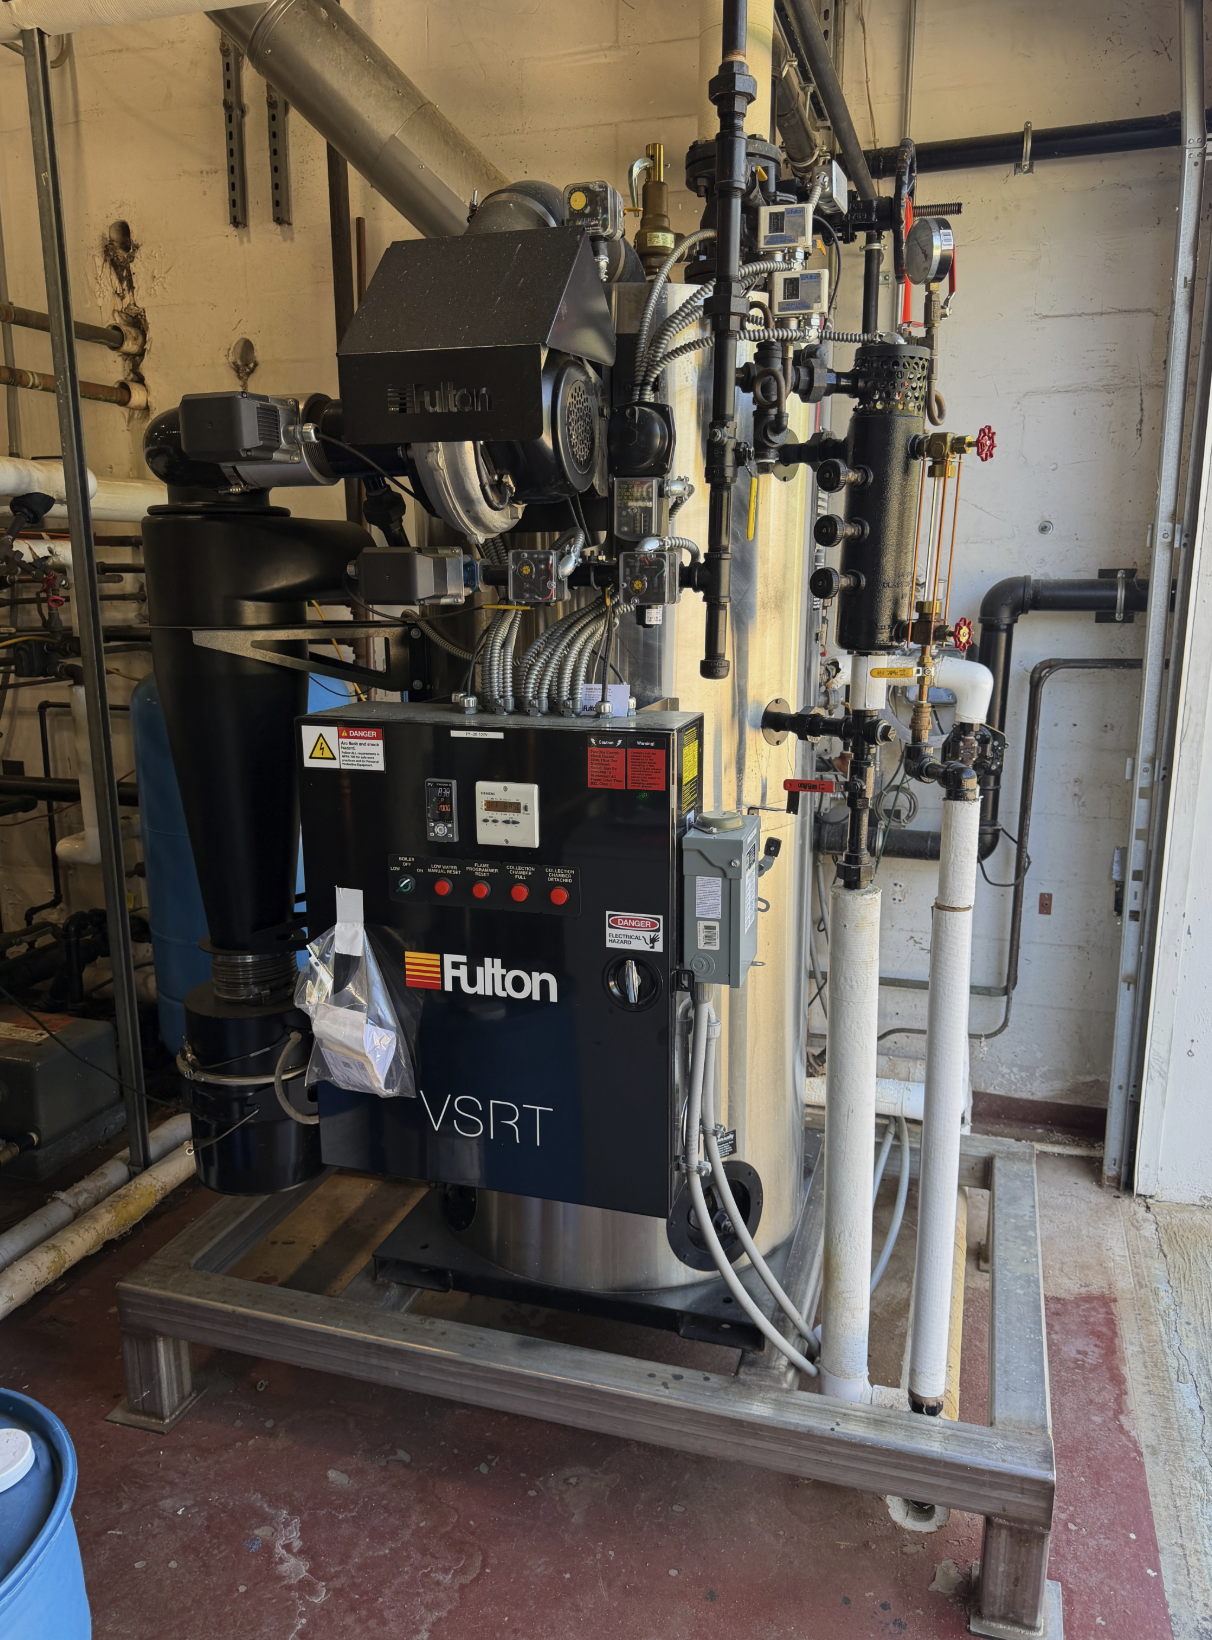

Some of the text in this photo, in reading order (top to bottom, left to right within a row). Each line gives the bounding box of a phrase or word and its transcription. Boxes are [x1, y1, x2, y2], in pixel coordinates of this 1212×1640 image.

[413, 382, 492, 413] Fulton
[349, 730, 377, 738] DANGER
[618, 918, 651, 928] DANGER
[608, 933, 642, 941] ELECTRICAL
[443, 953, 558, 1003] Fulton
[420, 1090, 554, 1146] VSRT
